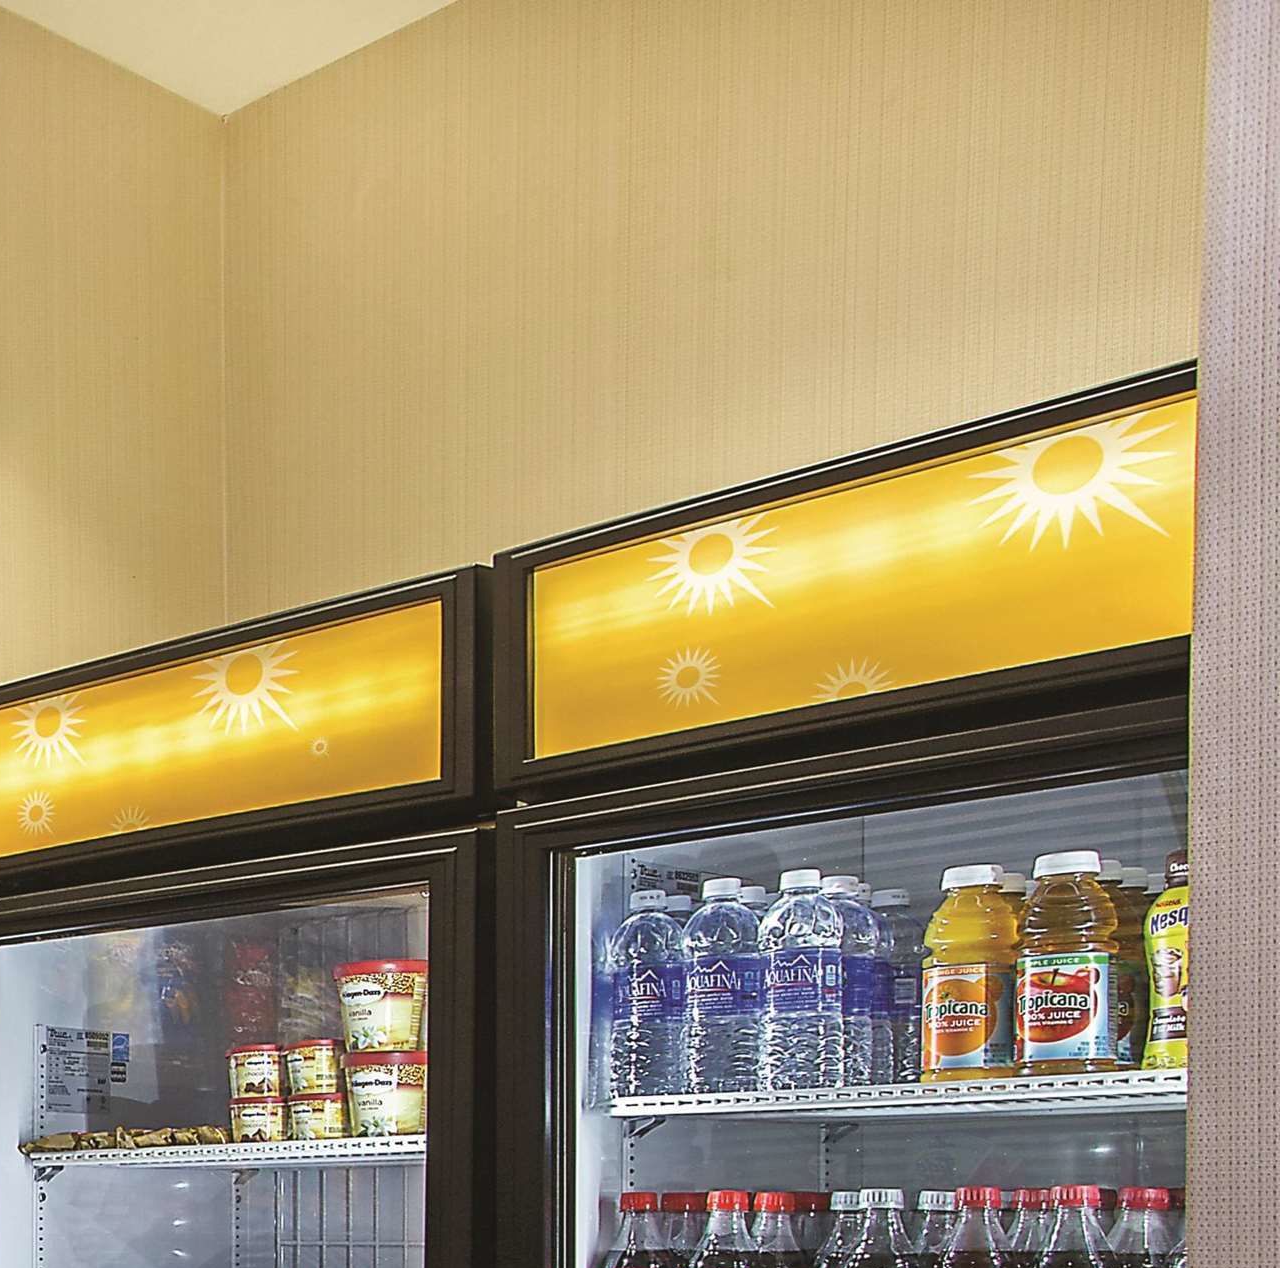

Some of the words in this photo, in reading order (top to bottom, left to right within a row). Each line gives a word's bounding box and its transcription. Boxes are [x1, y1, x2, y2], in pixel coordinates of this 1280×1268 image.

[1150, 905, 1189, 936] Nesq
[1051, 956, 1081, 965] JUICE
[1019, 991, 1089, 1014] Tropicana
[348, 1008, 373, 1017] vanilla
[1048, 1010, 1082, 1020] JUICE
[950, 1018, 982, 1028] JUICE
[357, 1099, 384, 1108] vanilla
